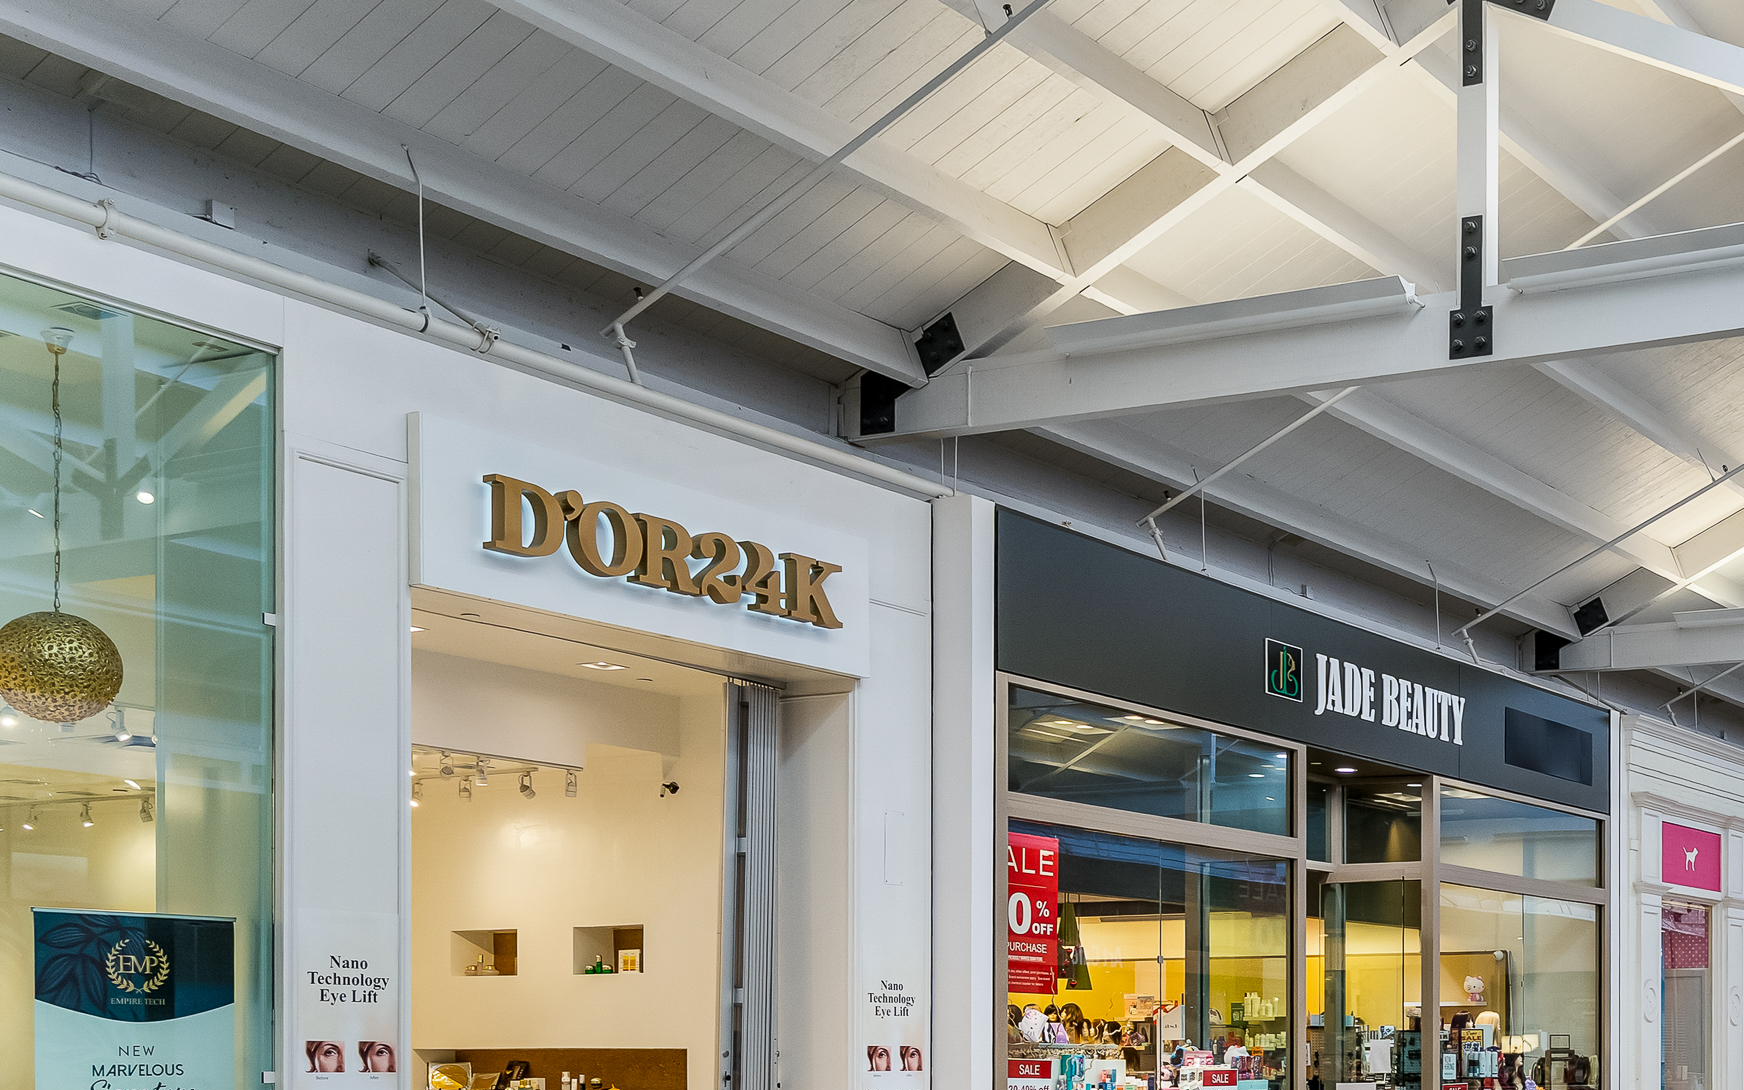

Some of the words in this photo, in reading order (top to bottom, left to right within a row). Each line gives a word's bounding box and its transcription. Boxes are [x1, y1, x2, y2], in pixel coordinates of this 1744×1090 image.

[1314, 653, 1375, 723] JADE
[1381, 673, 1466, 746] BEAUTY
[1032, 923, 1054, 935] OFF
[117, 955, 159, 974] EMP
[330, 955, 368, 969] Nano
[307, 971, 389, 990] Technology
[880, 980, 904, 991] Nano
[319, 989, 347, 1005] Eye
[351, 990, 378, 1003] Lift
[868, 993, 916, 1006] Technology
[875, 1006, 891, 1018] Eye
[893, 1006, 909, 1017] Lift
[118, 1046, 155, 1056] NEW
[92, 1064, 184, 1076] MARVELOUS
[1019, 1064, 1040, 1075] SALE
[1212, 1073, 1229, 1084] SALE
